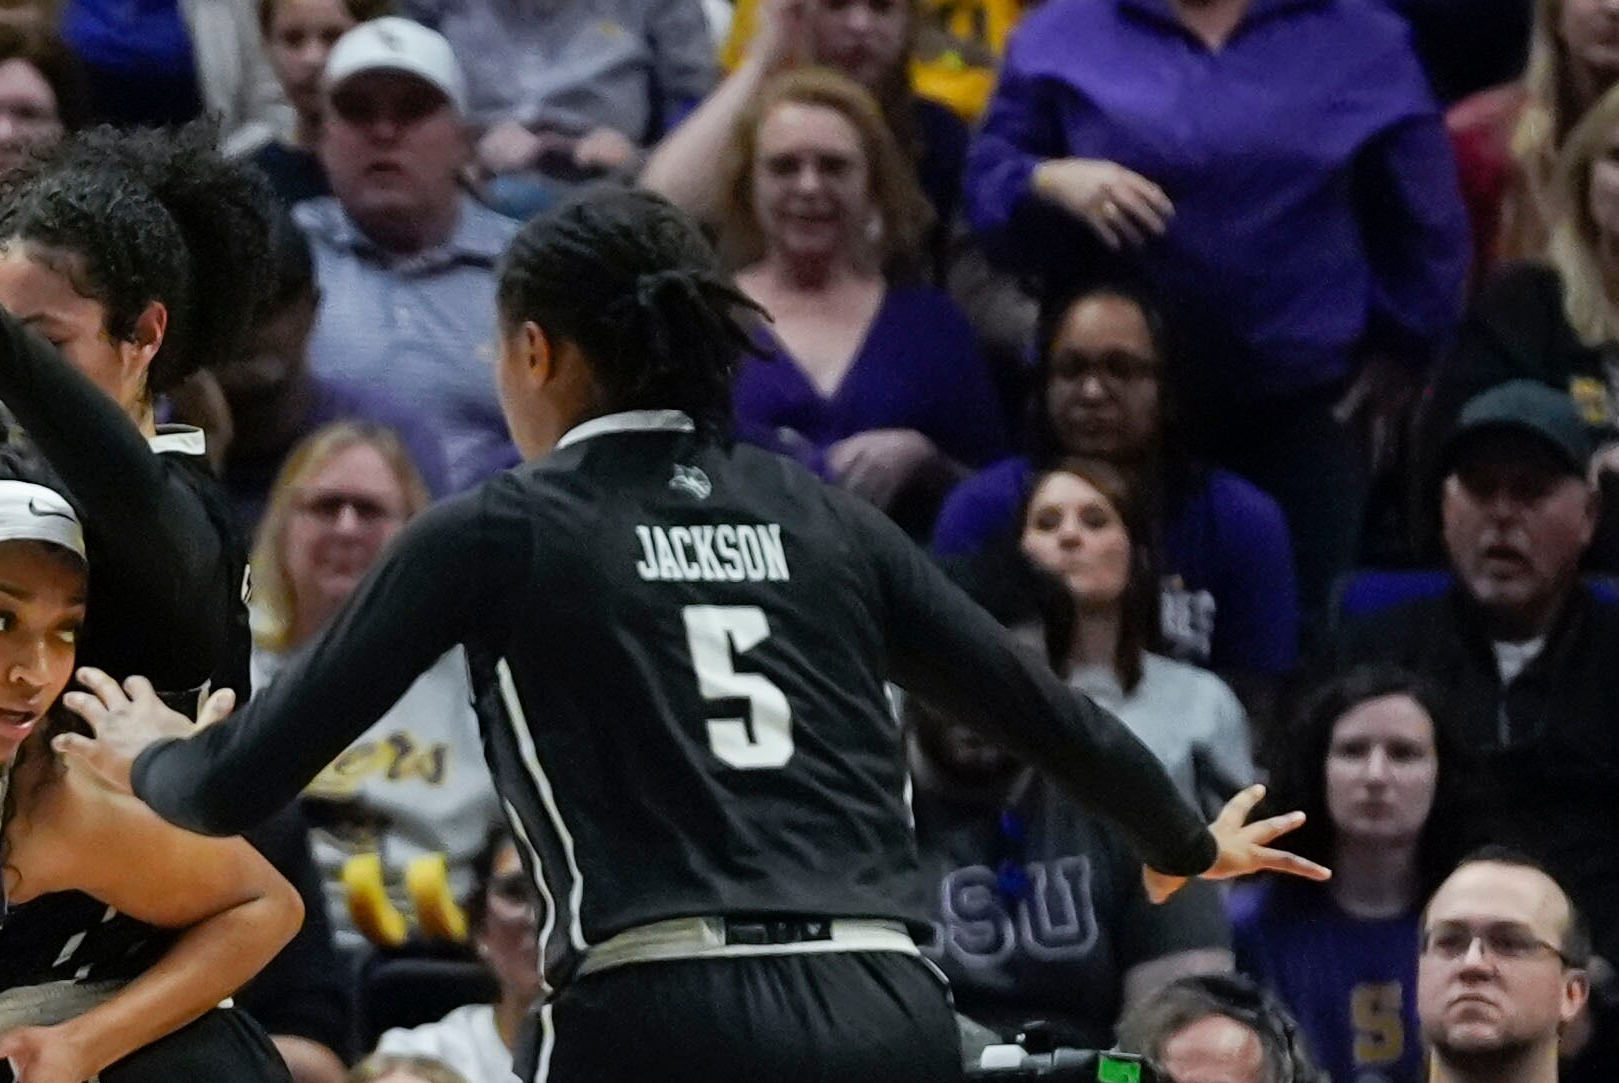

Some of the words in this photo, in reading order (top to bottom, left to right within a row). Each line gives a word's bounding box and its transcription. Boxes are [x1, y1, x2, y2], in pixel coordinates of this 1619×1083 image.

[635, 523, 790, 582] JACKSON
[683, 604, 795, 770] 5
[916, 855, 1100, 968] SU
